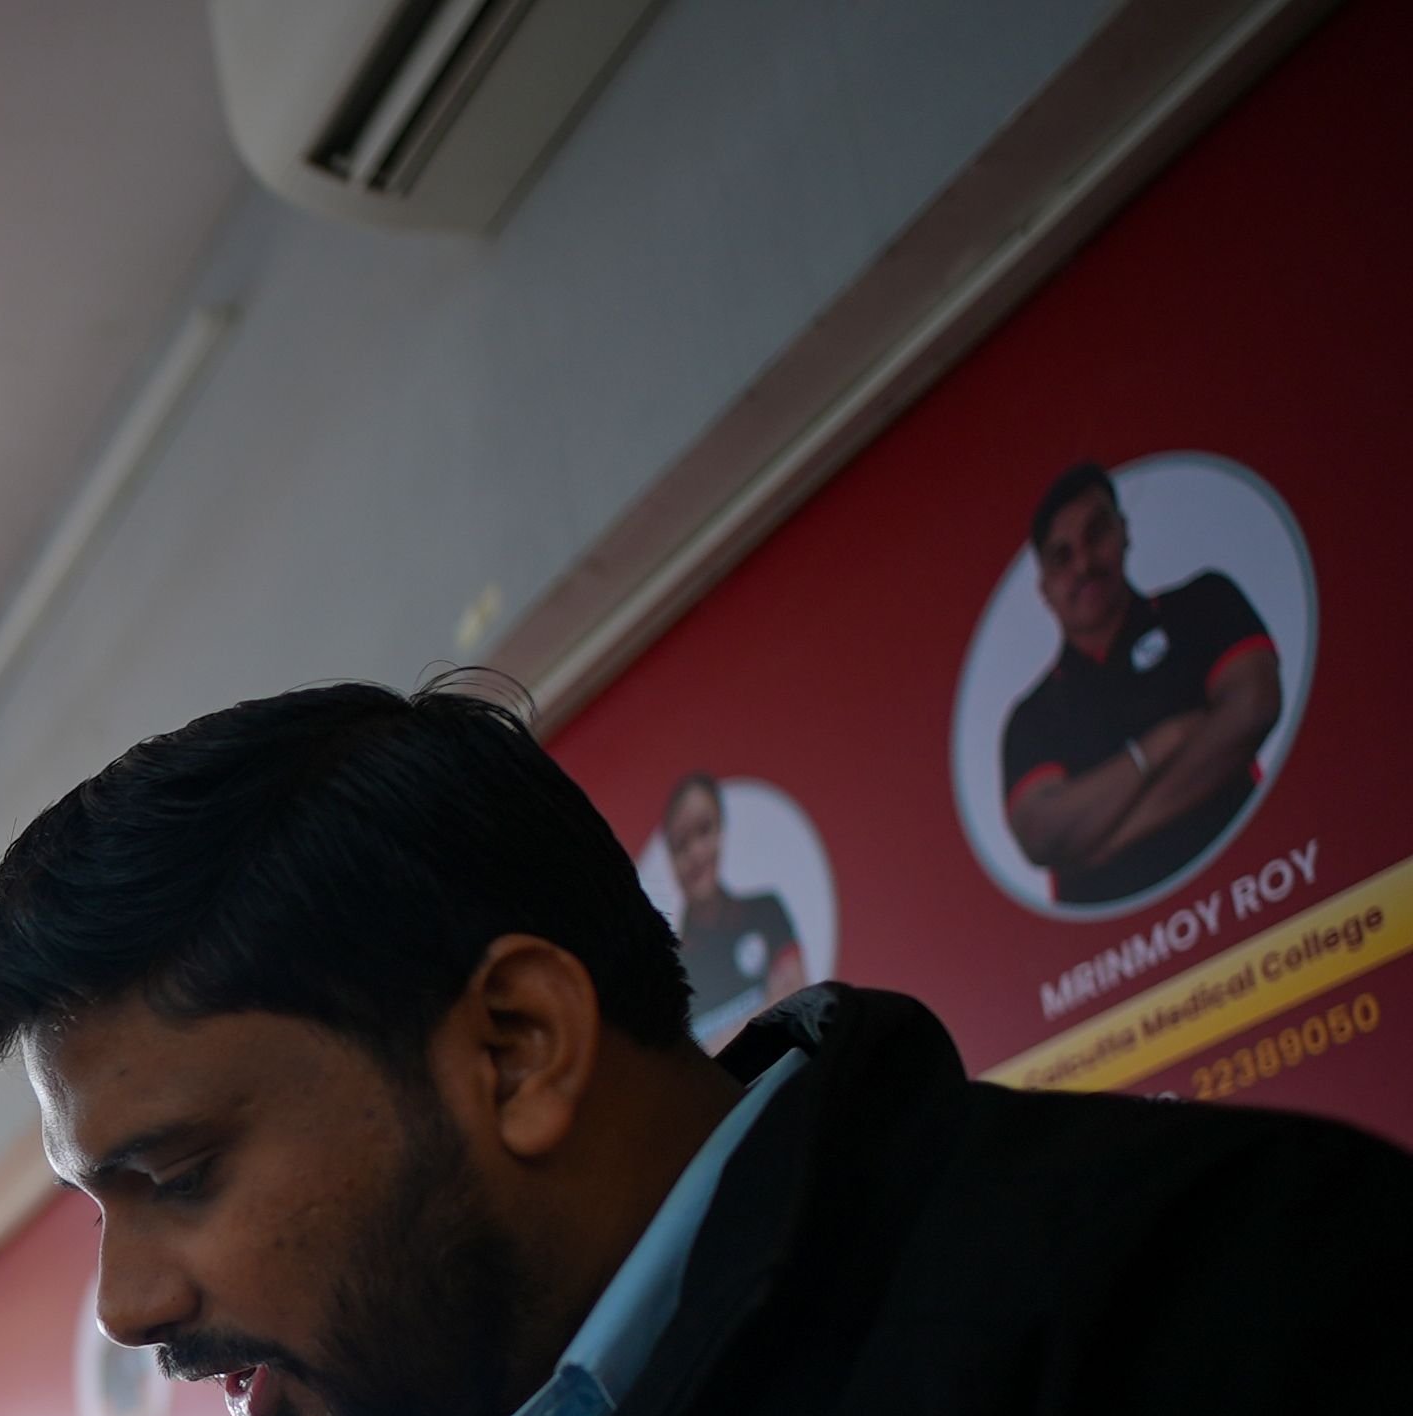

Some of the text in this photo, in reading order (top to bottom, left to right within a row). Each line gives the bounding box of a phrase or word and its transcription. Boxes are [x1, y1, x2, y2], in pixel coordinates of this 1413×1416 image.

[1039, 838, 1319, 1020] MRINMOY ROY
[1141, 964, 1256, 1037] Medical
[1261, 905, 1385, 982] College
